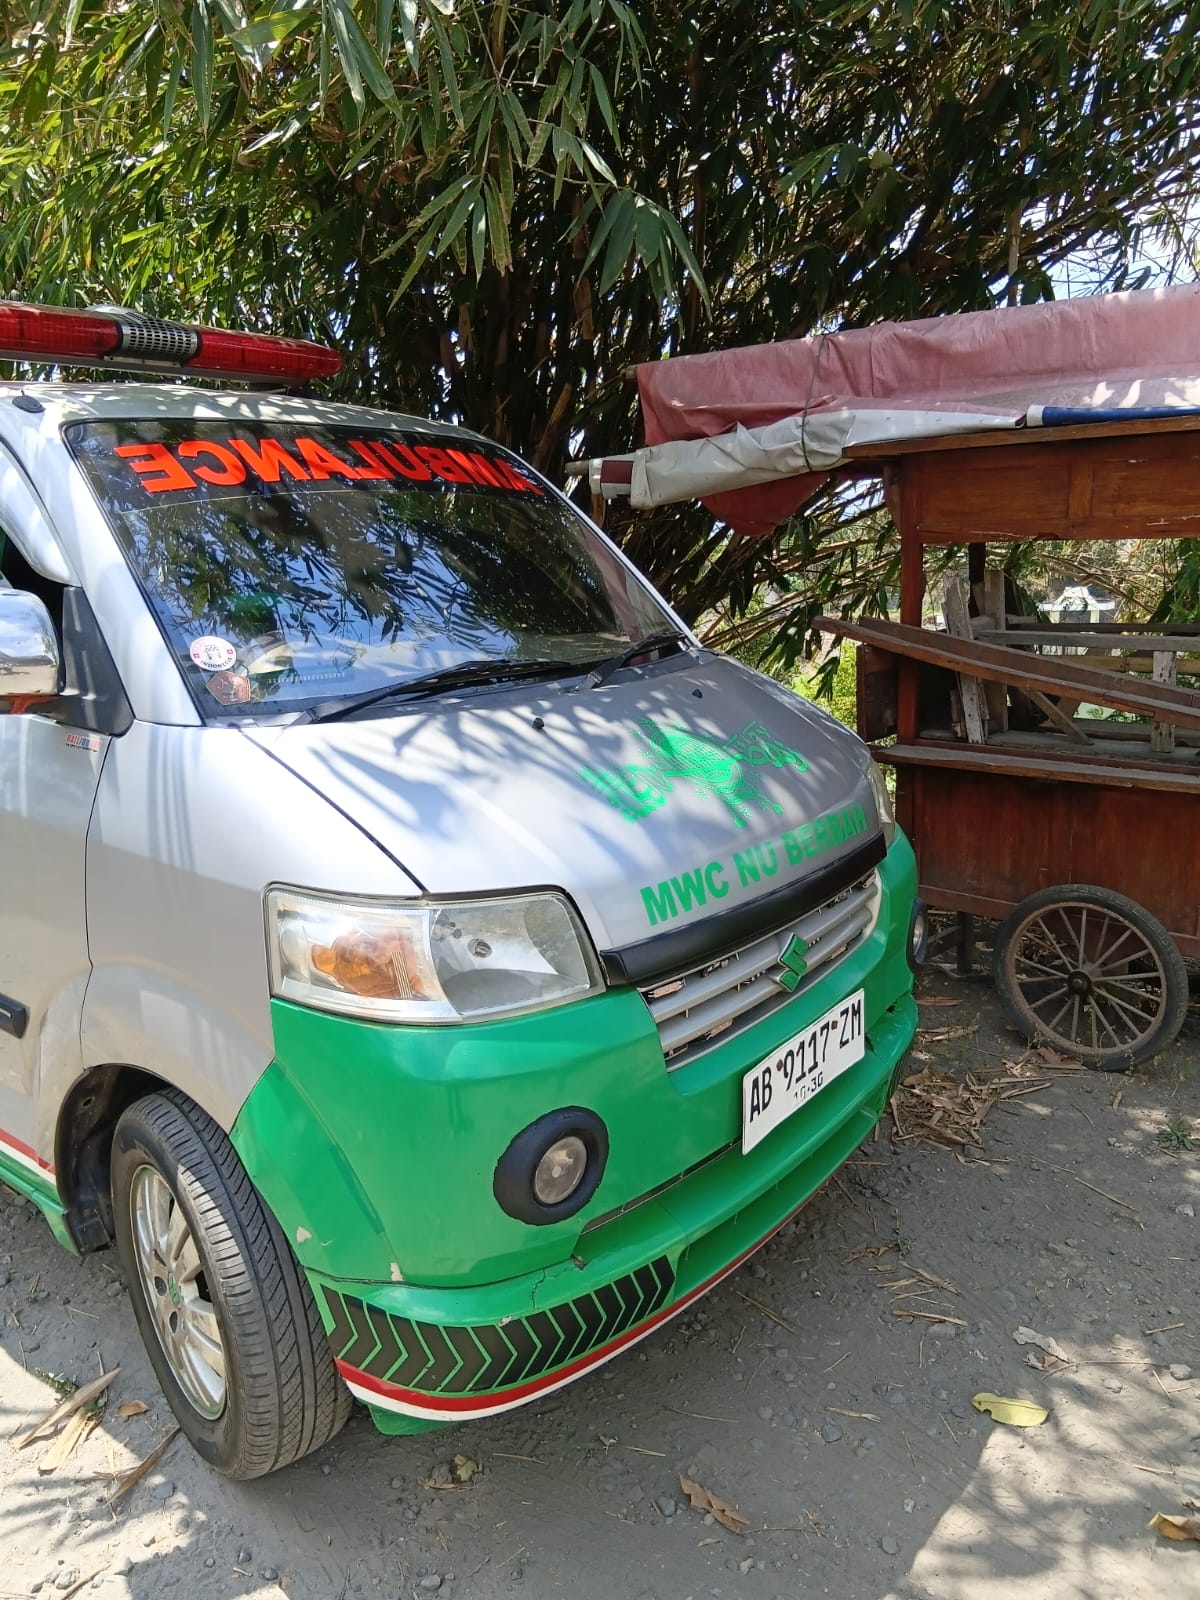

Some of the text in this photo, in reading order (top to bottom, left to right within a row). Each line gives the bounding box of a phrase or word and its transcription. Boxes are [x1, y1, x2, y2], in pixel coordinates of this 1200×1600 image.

[640, 803, 868, 926] MWC NU BERBAH
[750, 999, 861, 1122] AB 9117 ZM
